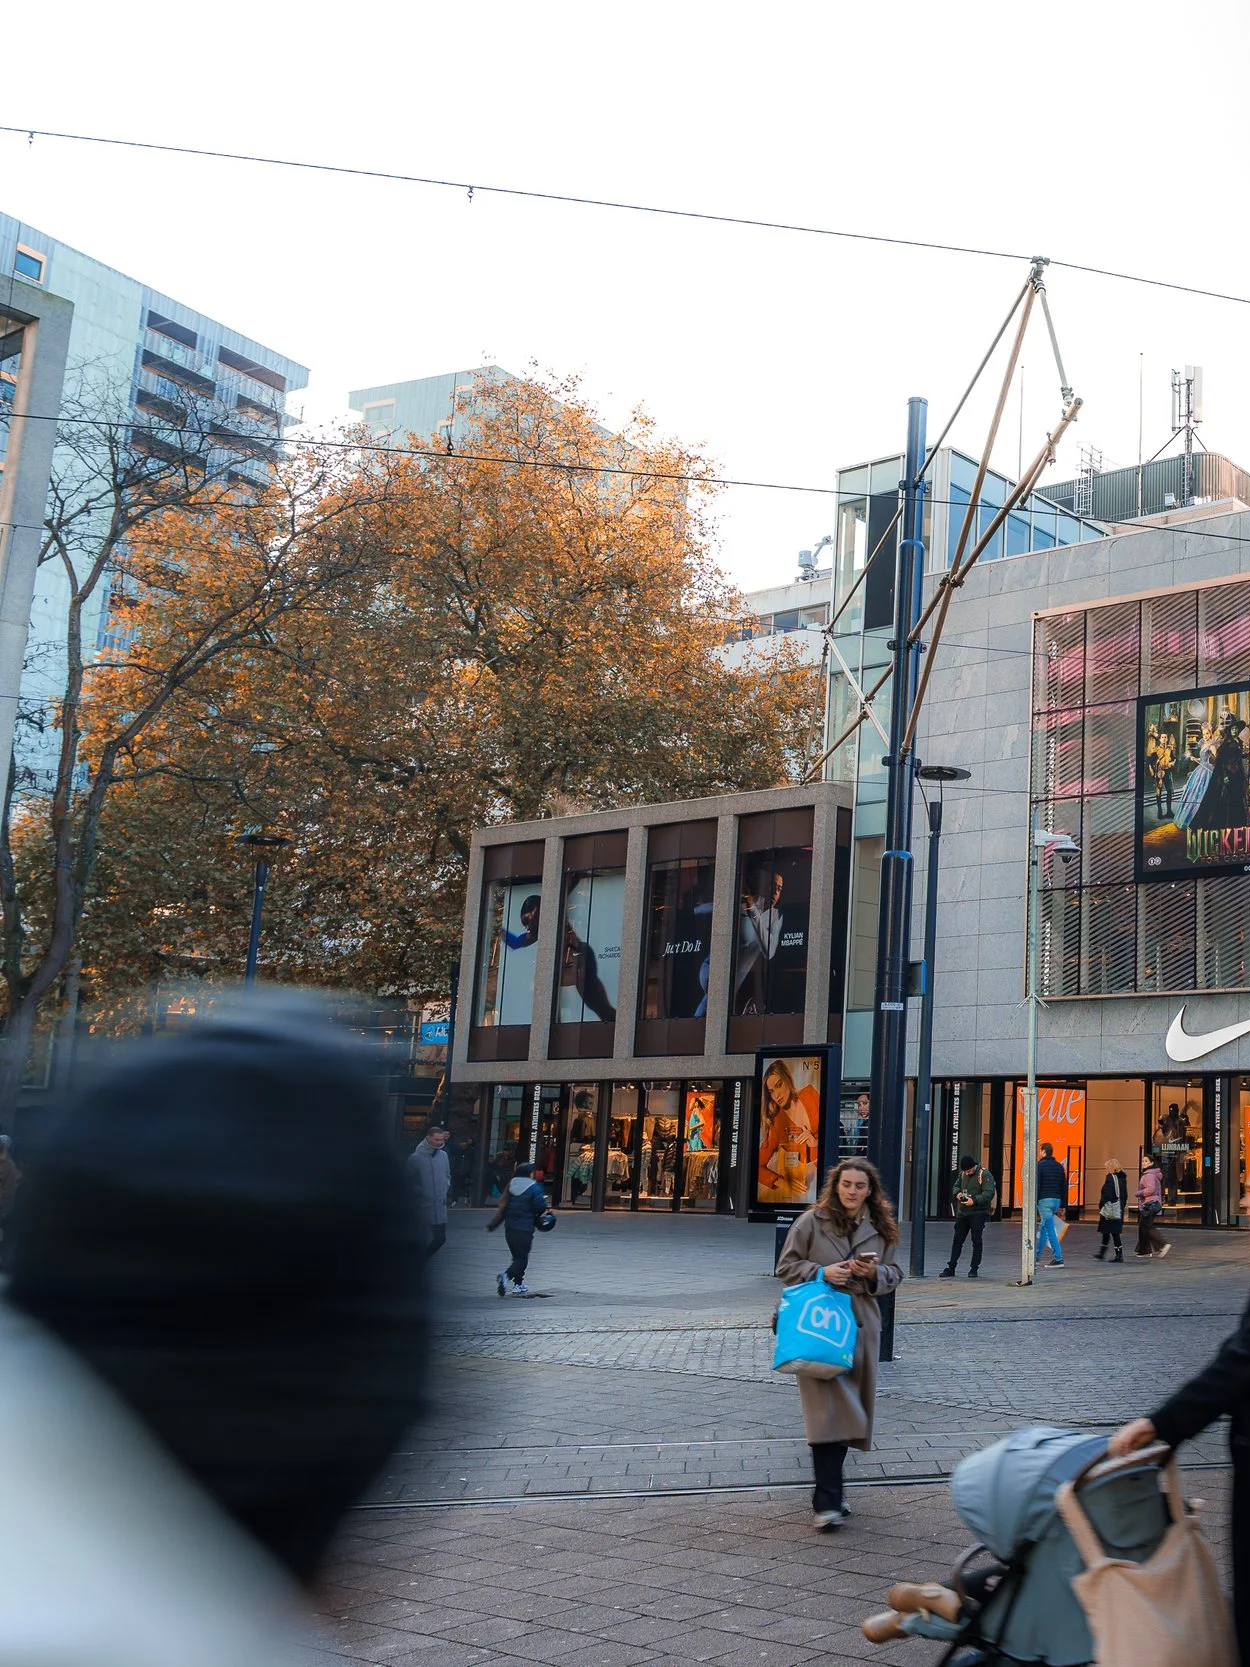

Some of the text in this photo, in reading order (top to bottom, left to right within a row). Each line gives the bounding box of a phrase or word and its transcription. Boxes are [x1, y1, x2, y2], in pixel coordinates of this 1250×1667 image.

[783, 932, 804, 940] KYLIAN
[662, 939, 702, 957] Jut Do It
[531, 1101, 540, 1130] ATHLETES
[732, 1099, 740, 1130] ATHLETES
[952, 1098, 960, 1130] ATHLETES
[530, 1131, 538, 1142] ALL
[528, 1143, 537, 1165] WHERE
[730, 1144, 738, 1168] WHERE
